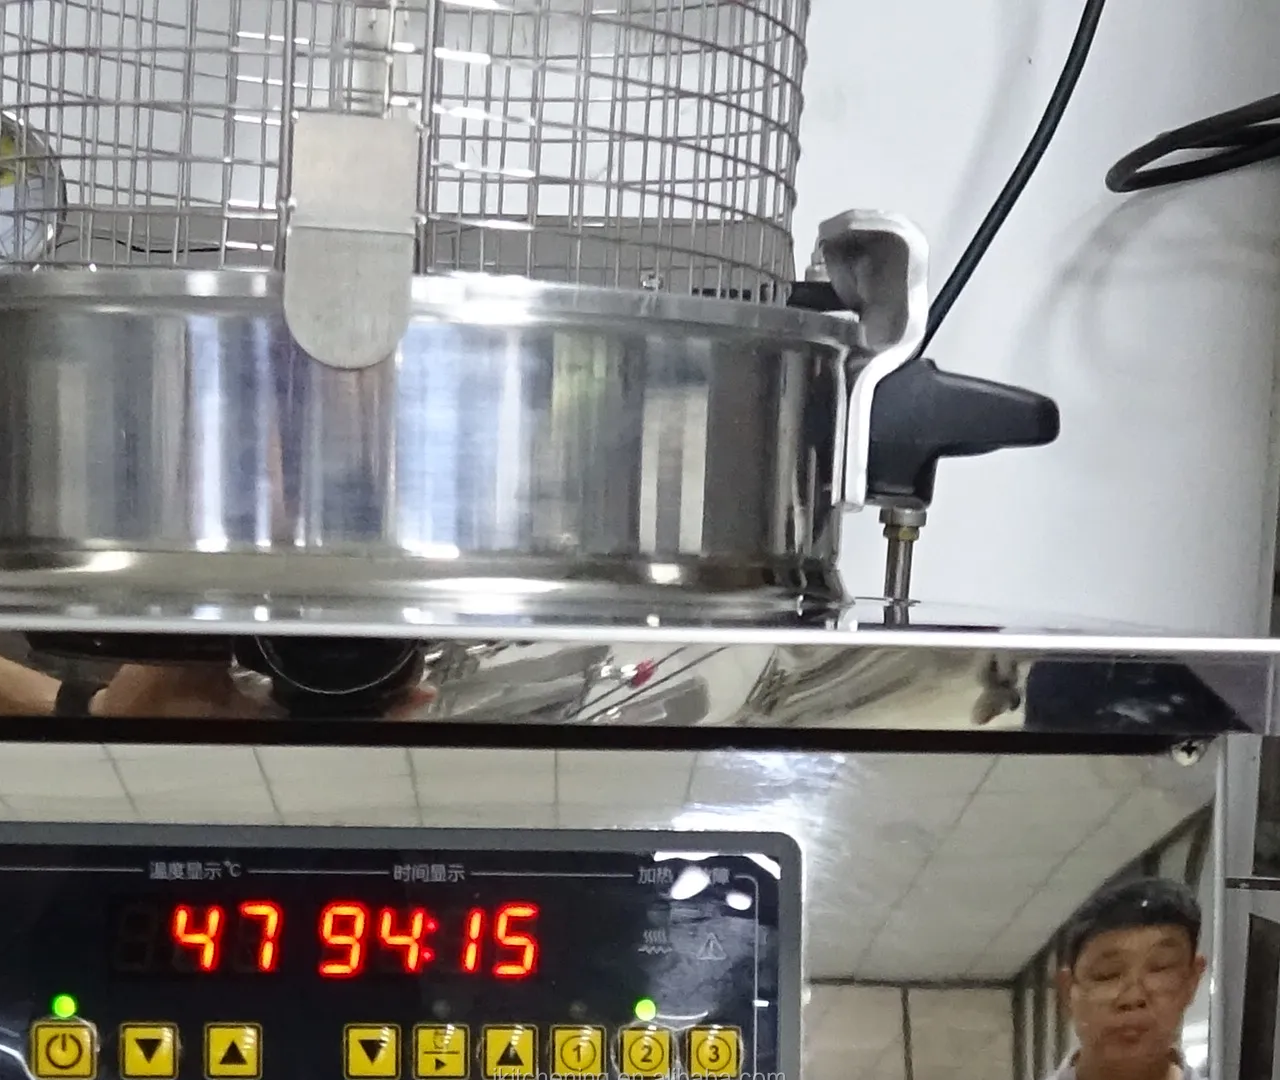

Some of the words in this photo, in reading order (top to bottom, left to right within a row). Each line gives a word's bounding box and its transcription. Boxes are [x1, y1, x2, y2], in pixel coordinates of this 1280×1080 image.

[393, 864, 466, 883] 时间显示
[172, 902, 280, 972] 47
[320, 899, 540, 978] 94:15
